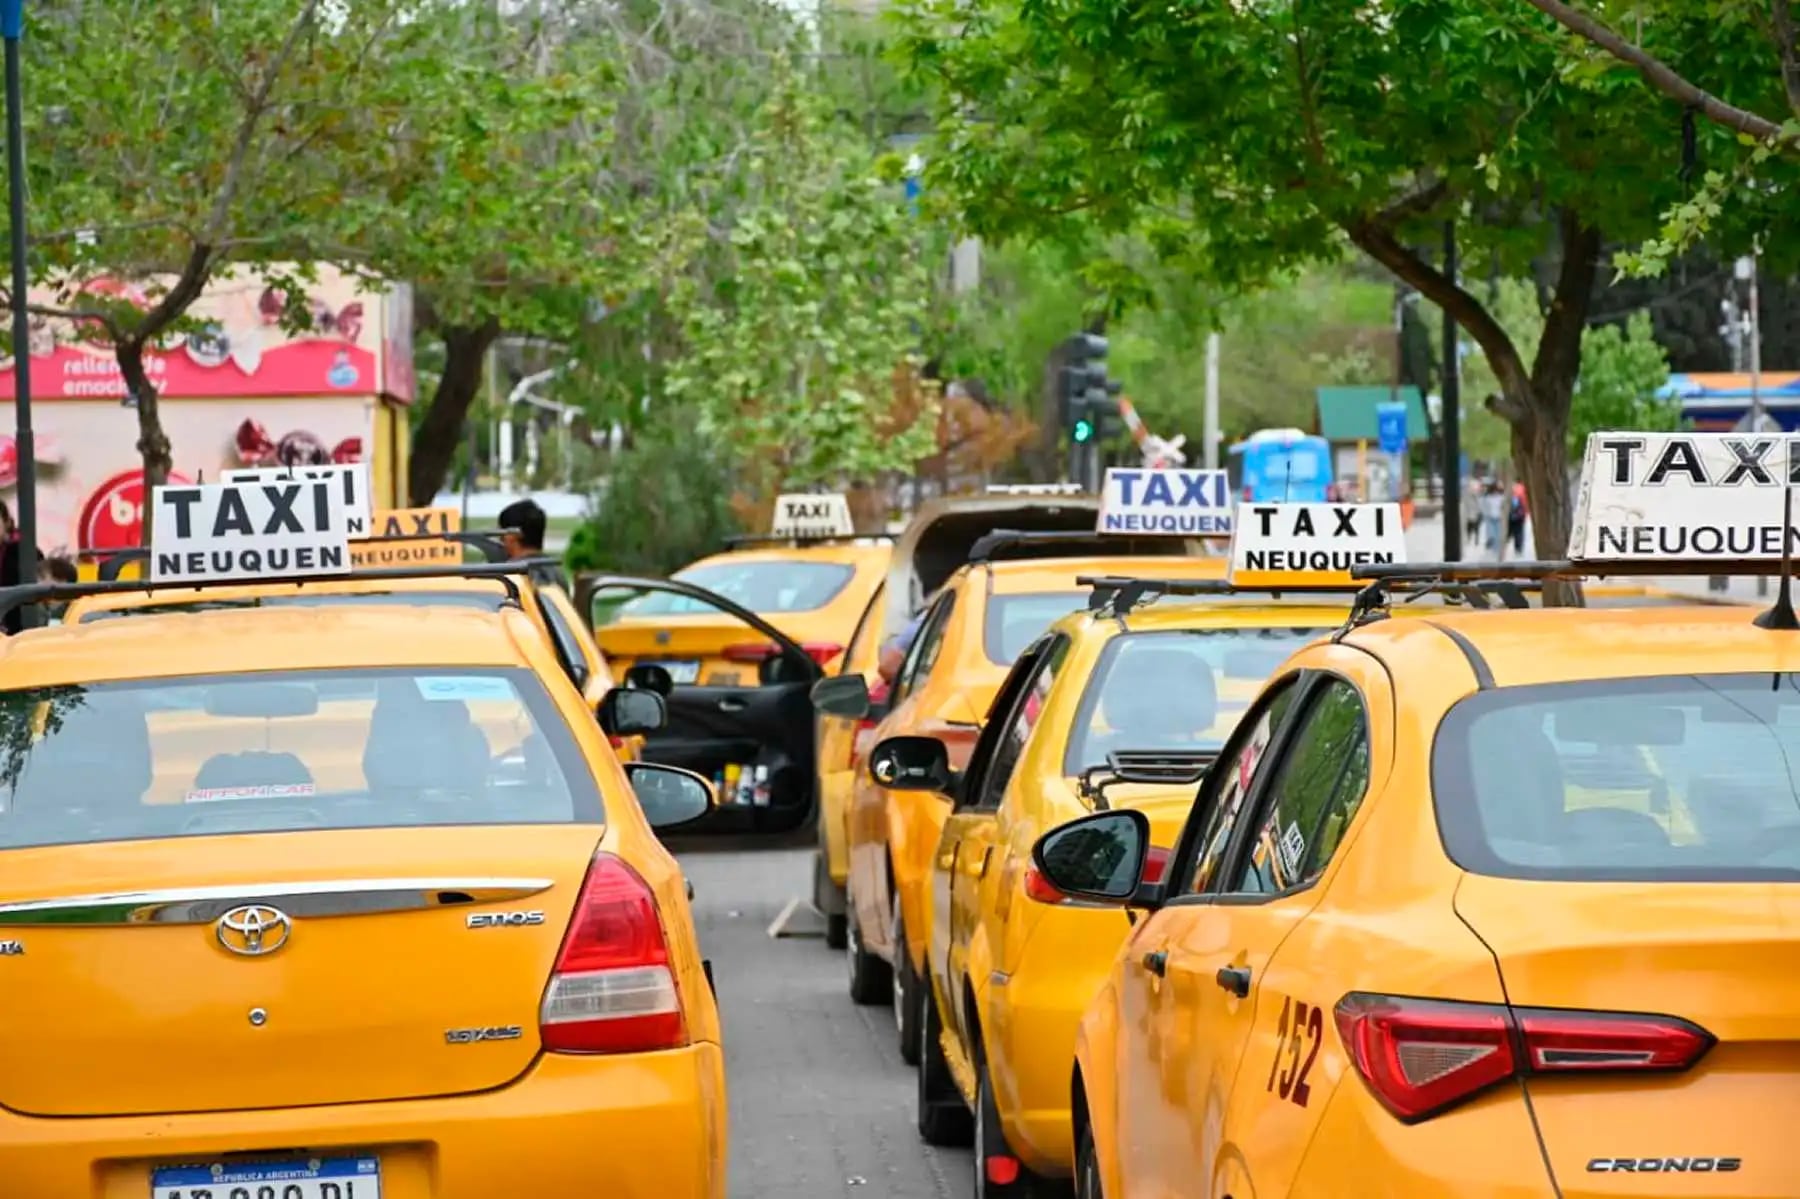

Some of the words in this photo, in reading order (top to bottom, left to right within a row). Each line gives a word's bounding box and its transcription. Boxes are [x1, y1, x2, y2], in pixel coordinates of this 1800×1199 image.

[1111, 472, 1226, 508] TAXI
[162, 483, 330, 539] TAXI
[785, 503, 830, 518] TAXI
[1253, 507, 1384, 537] TAXI
[371, 511, 450, 537] AXI
[1106, 512, 1231, 533] NEUQUEN
[158, 545, 343, 576] NEUQUEN
[351, 545, 456, 565] NEUQUEN
[1245, 550, 1393, 571] NEUQUEN
[466, 910, 545, 929] ETIOS
[1266, 994, 1324, 1109] 152
[1585, 1157, 1742, 1173] CRONOS
